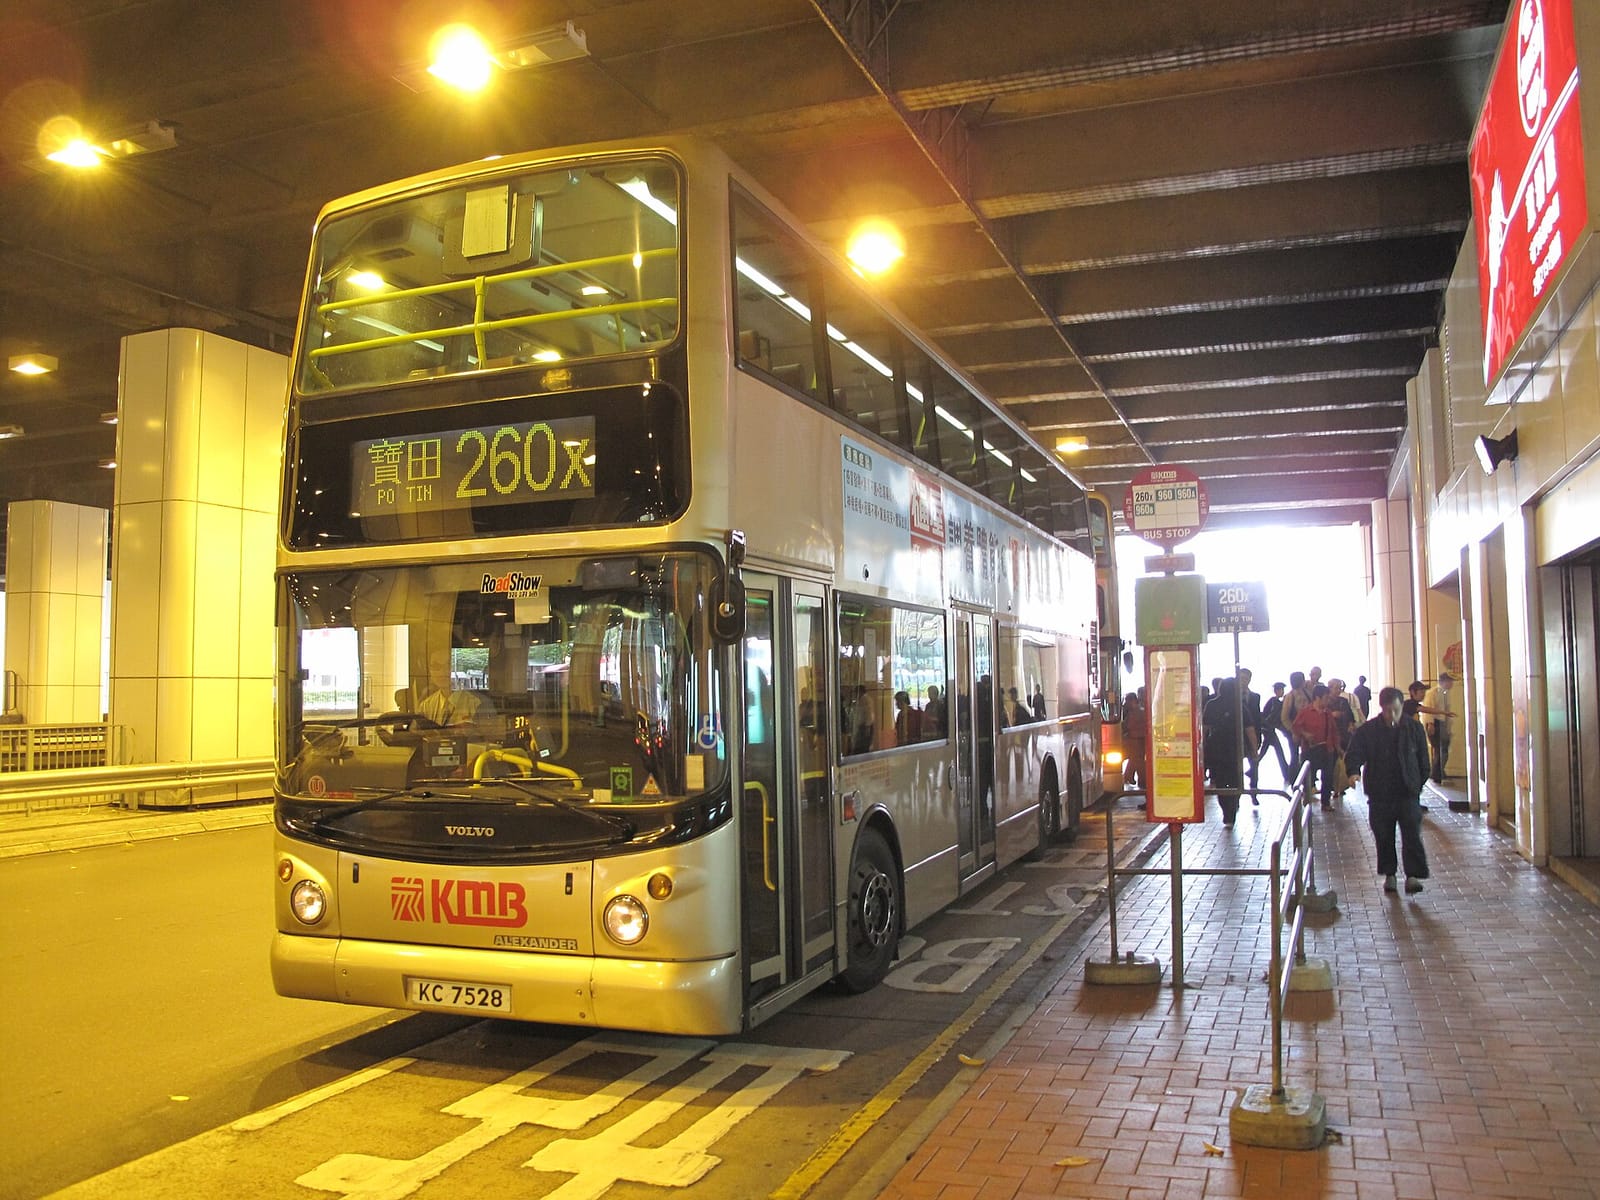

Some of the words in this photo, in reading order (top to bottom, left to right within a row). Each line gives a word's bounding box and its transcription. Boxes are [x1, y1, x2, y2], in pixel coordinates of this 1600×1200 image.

[377, 488, 395, 505] PO
[406, 484, 432, 503] TIN
[1157, 489, 1173, 500] 960
[1177, 488, 1196, 500] 960A
[1135, 503, 1154, 515] 960B
[1143, 529, 1163, 540] BUS
[1166, 528, 1191, 539] STOP
[481, 573, 541, 592] RoadShow
[1217, 616, 1226, 624] TO
[1230, 615, 1239, 623] PO
[445, 825, 495, 838] VOLVO
[494, 935, 577, 950] ALEXANDER
[418, 982, 443, 1002] KC
[452, 986, 503, 1008] 7528
